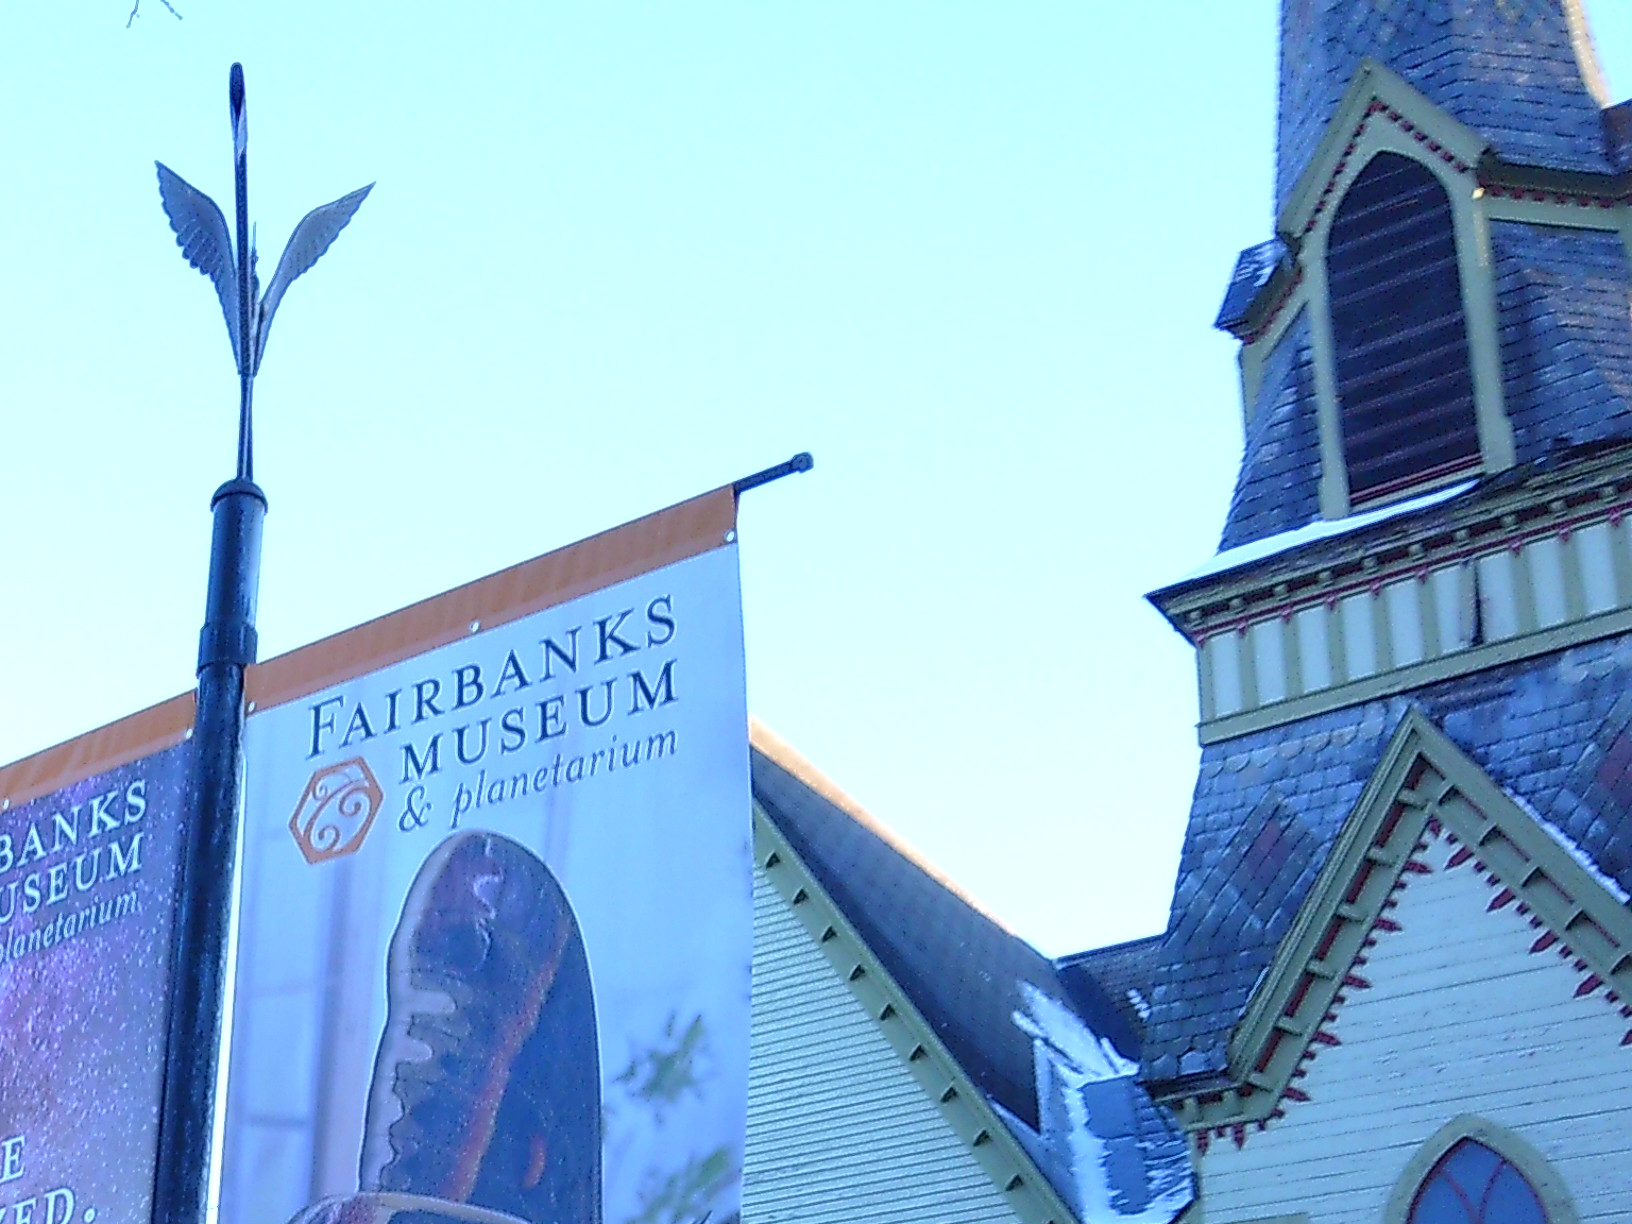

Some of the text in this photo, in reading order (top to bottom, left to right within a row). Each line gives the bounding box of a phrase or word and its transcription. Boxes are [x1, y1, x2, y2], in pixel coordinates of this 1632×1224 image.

[308, 595, 678, 756] FAIRBANKS
[399, 660, 679, 783] MUSEUM
[398, 730, 679, 832] & planetarium
